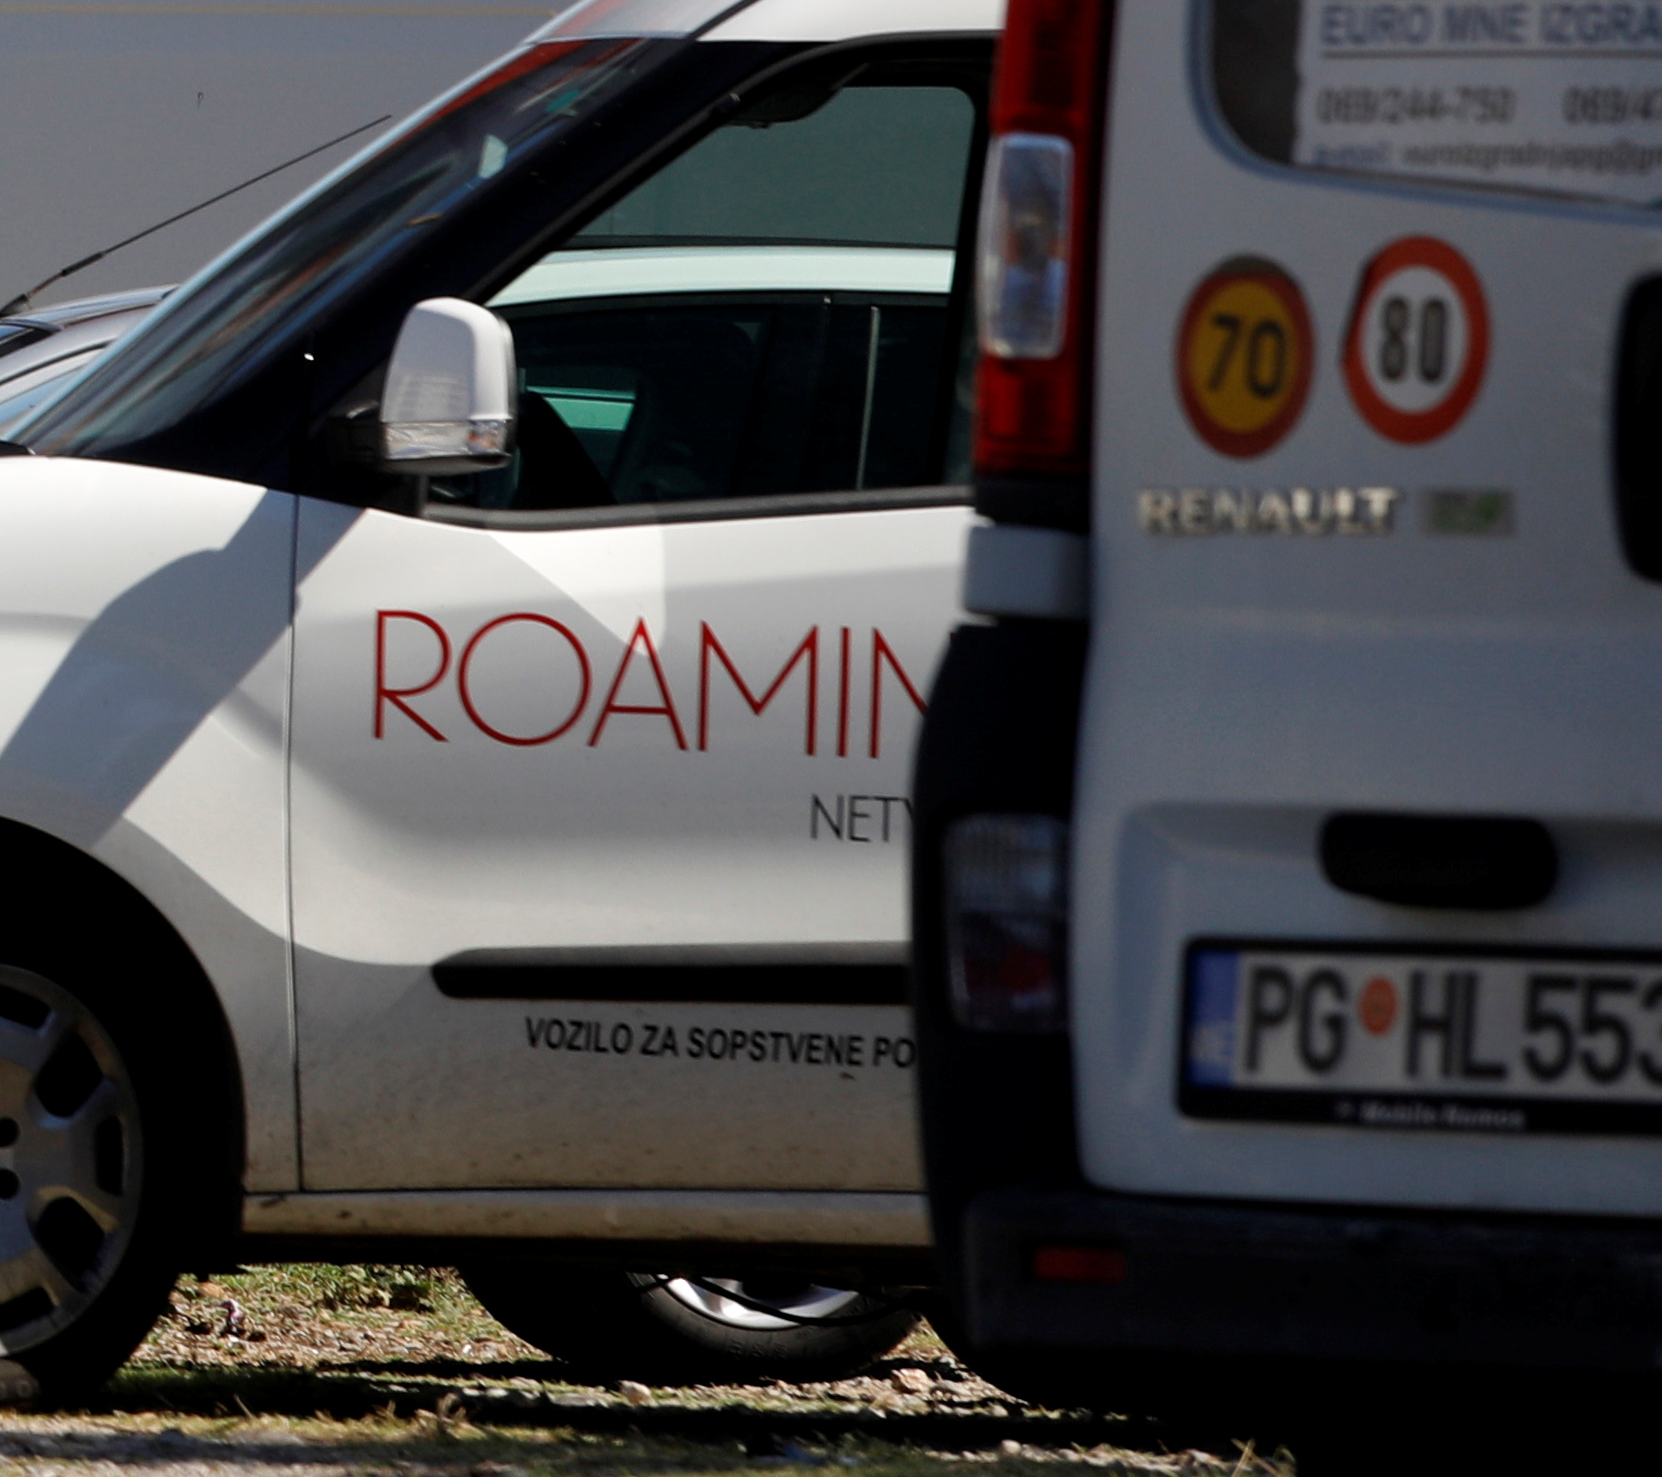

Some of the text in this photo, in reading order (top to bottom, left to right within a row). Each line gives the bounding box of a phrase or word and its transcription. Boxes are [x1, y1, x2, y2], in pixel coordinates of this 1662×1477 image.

[1208, 313, 1288, 399] 70
[1379, 297, 1449, 385] 80
[1139, 486, 1401, 535] RENAULT
[526, 1017, 634, 1056] VOZILO
[639, 1024, 679, 1058] ZA
[686, 1026, 864, 1068] SOPSTVENE
[1244, 964, 1350, 1075] PG
